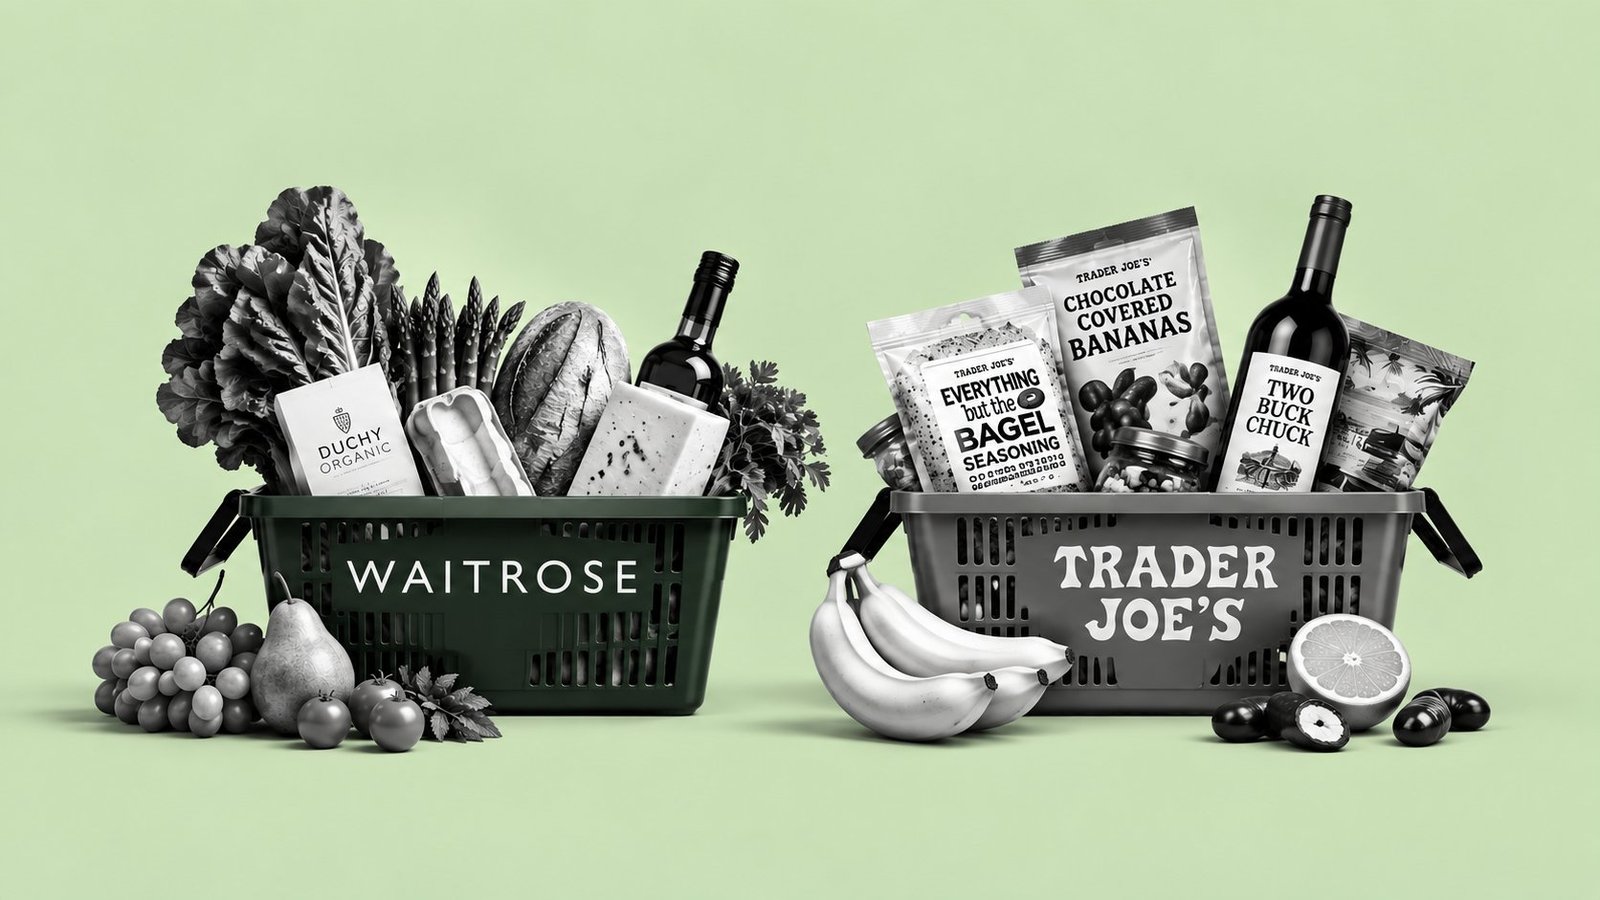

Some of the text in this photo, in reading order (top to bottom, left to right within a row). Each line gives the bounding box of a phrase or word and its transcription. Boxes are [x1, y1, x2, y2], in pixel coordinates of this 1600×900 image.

[1076, 265, 1118, 283] TRADER
[1063, 271, 1177, 312] CHOCOLATE
[1077, 293, 1173, 331] COVERED
[1068, 311, 1192, 361] BANANAS
[940, 368, 1040, 406] EVERYTHING
[954, 363, 989, 378] TRADER
[1269, 364, 1299, 377] TRADER
[961, 396, 1017, 421] but the
[1267, 379, 1315, 405] TWO
[1256, 397, 1314, 426] BUCK
[318, 427, 381, 459] DUCHY
[954, 410, 1056, 453] BAGEL
[1246, 416, 1314, 447] CHUCK
[320, 442, 391, 474] ORGANIC
[963, 436, 1060, 471] SEASONING
[346, 560, 637, 594] WAITROSE
[1053, 545, 1278, 588] TRADER
[1085, 596, 1245, 641] JOE'S
